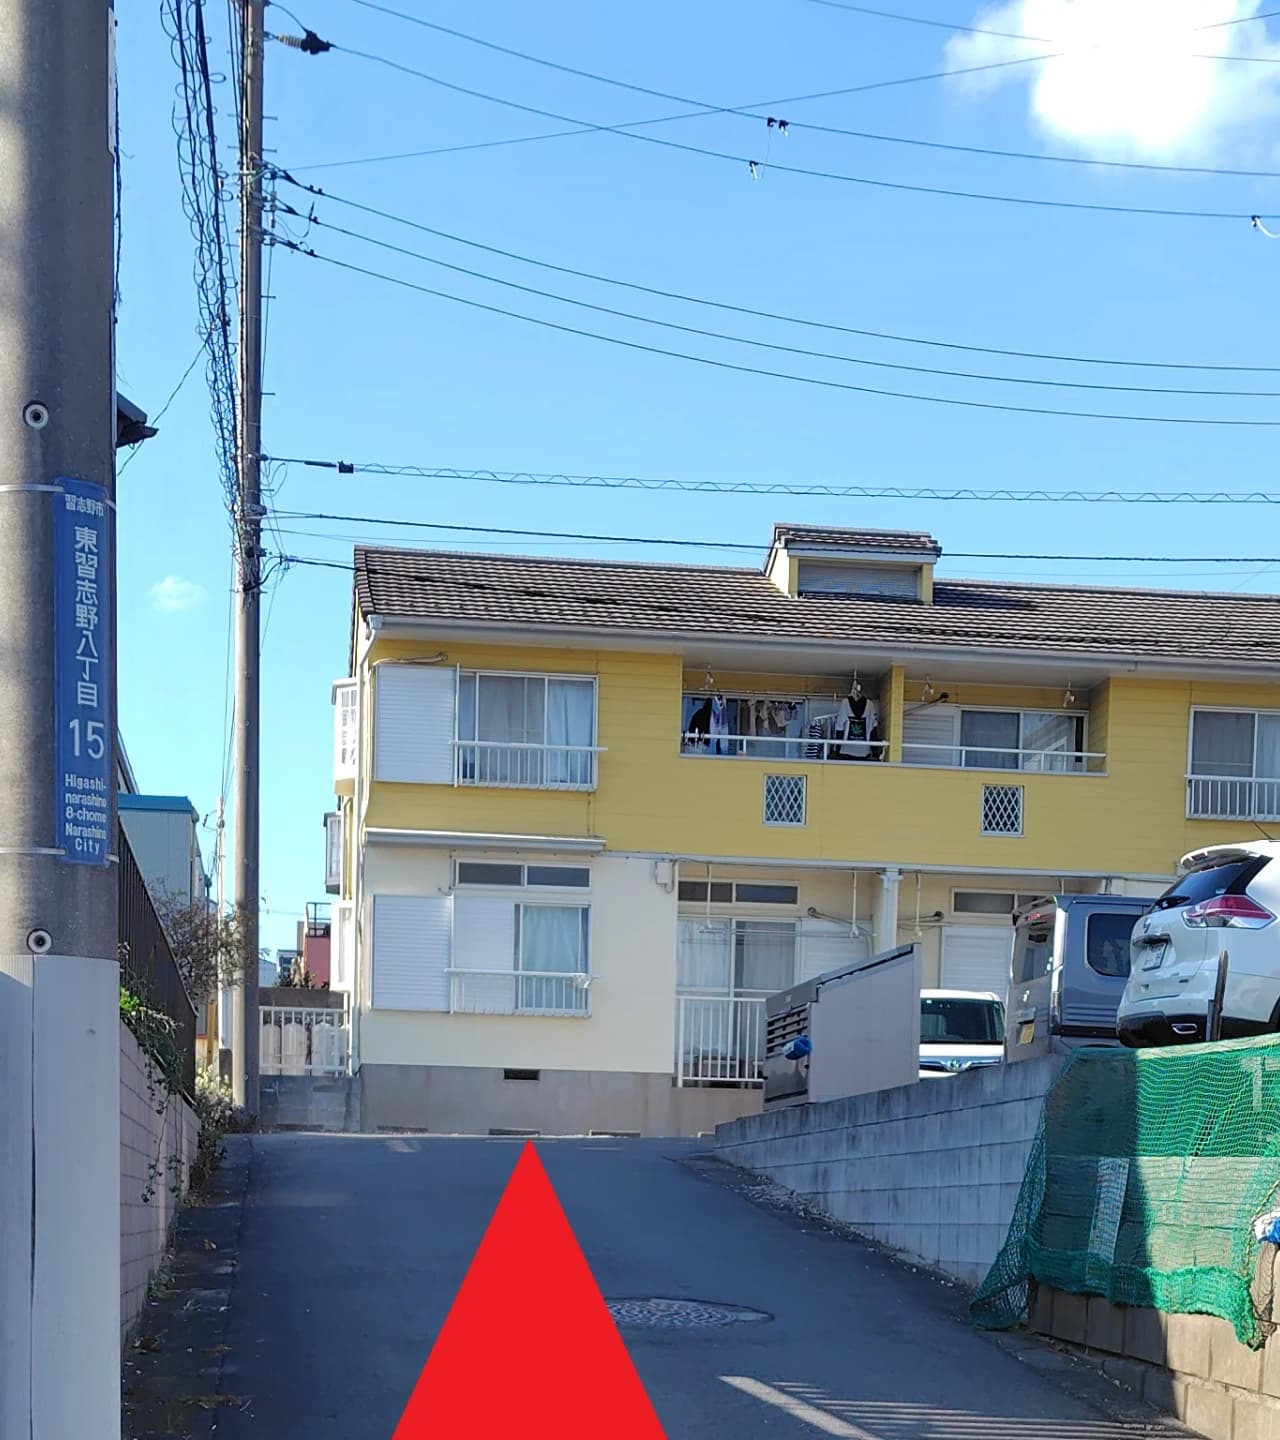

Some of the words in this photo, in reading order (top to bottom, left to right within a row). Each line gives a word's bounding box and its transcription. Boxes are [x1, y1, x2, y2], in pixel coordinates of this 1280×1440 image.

[65, 494, 104, 517] 習志野市
[74, 526, 99, 708] 東習志野八丁目
[69, 718, 105, 760] 15
[65, 773, 107, 790] Higashi-
[65, 792, 107, 808] narashino
[65, 807, 107, 823] 8-chome
[65, 822, 107, 840] Narashino
[75, 838, 100, 855] City
